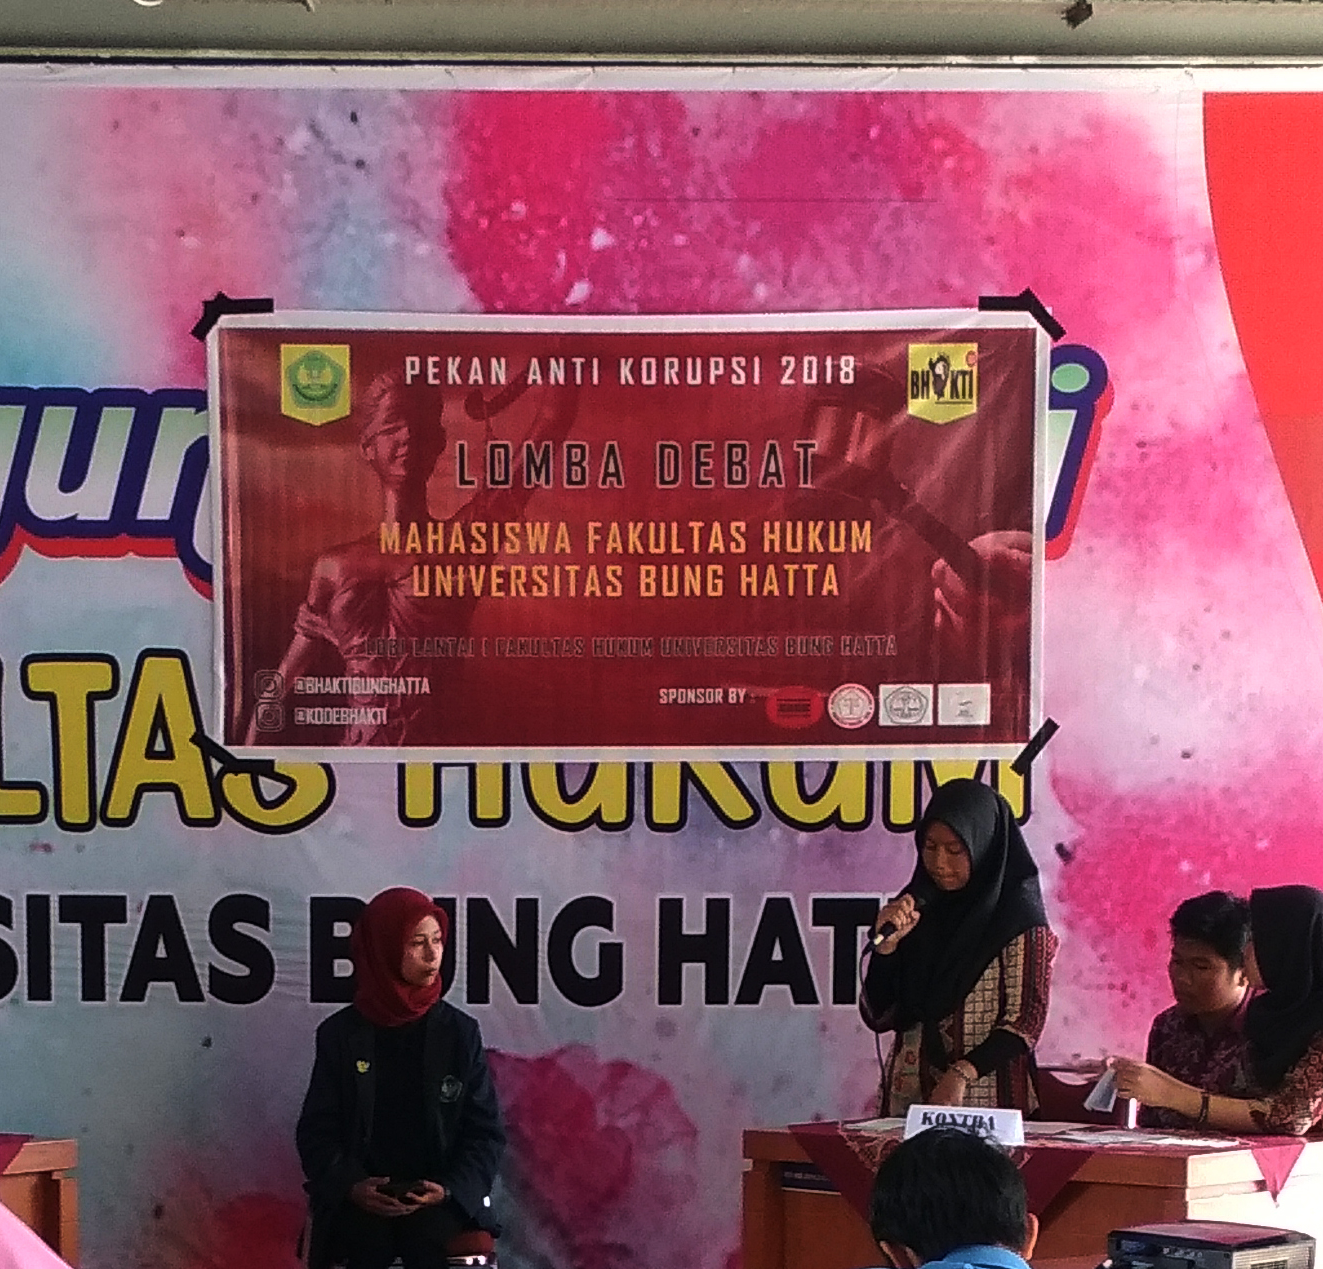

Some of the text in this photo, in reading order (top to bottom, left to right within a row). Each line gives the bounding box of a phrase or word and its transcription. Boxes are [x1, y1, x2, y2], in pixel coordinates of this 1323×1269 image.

[405, 355, 856, 385] PEKAN ANTI KORUPSI 2018
[456, 440, 818, 488] LOMBA DEBAT
[380, 521, 873, 554] MAHASISWA FAKULTAS HUKUM
[413, 564, 840, 597] UNIVERSITAS BUNG HATTA
[495, 636, 584, 657] FAKULTAS
[592, 636, 653, 657] HUKUM
[660, 636, 778, 657] UNIVERSITAS
[786, 635, 834, 656] BUNG
[842, 635, 897, 656] HATTA
[659, 688, 747, 705] SPONSOR BY
[309, 895, 624, 1007] BNG
[657, 896, 902, 1006] HAT
